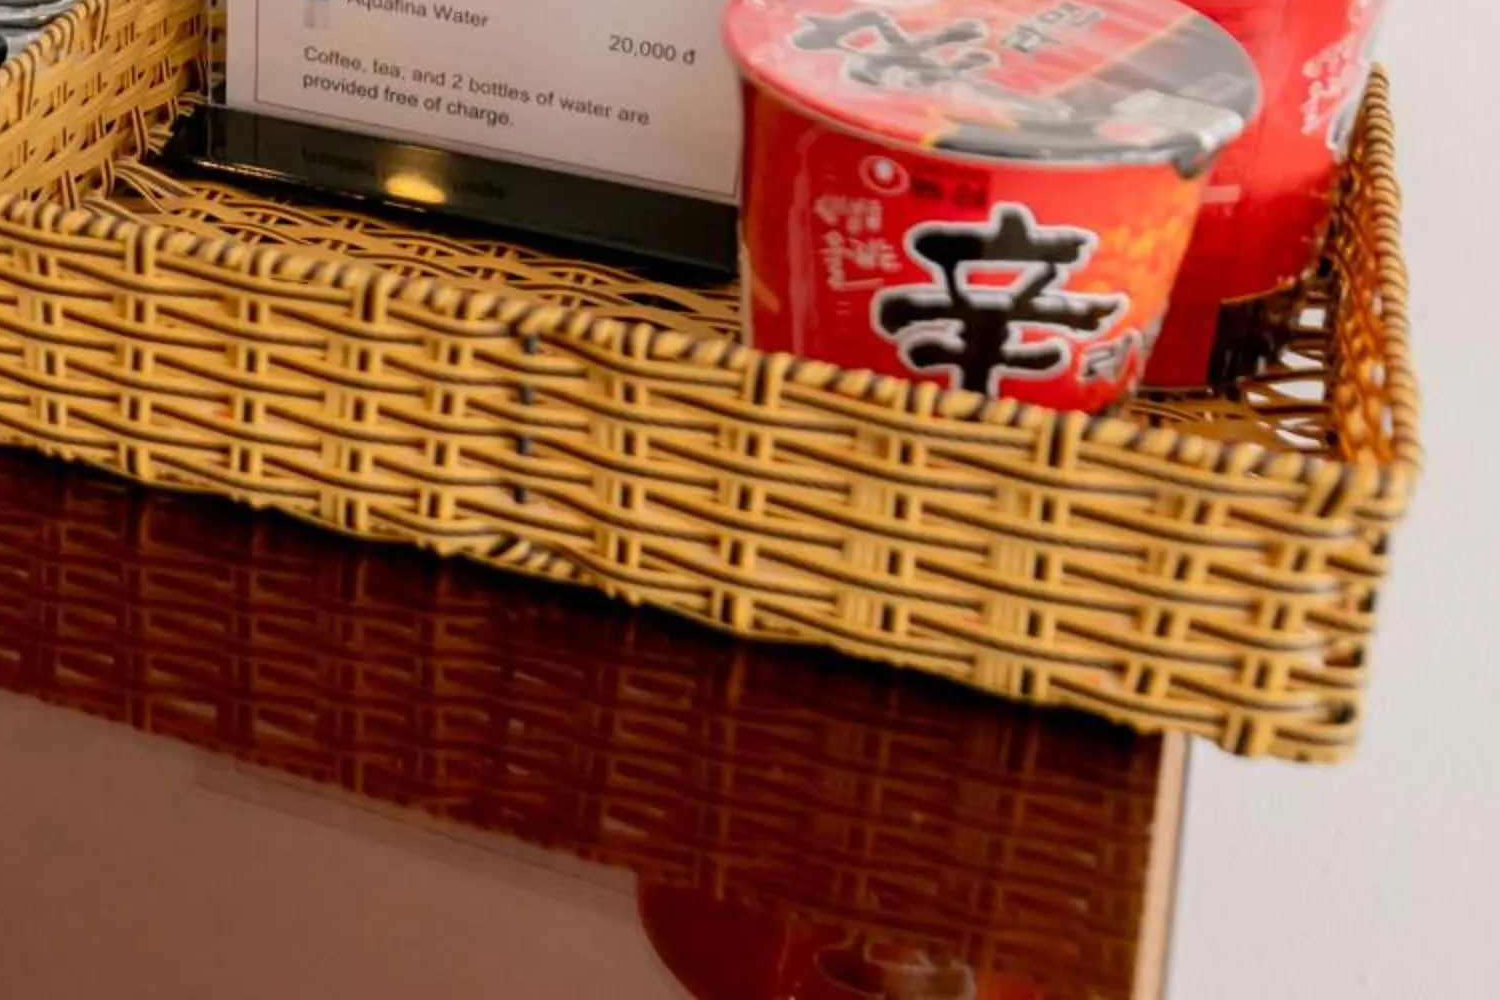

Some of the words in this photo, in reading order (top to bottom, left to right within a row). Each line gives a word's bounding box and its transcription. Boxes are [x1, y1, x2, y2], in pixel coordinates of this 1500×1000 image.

[432, 3, 489, 28] Water
[303, 45, 367, 73] Coffee,
[373, 59, 405, 81] tea,
[412, 67, 446, 88] and
[451, 73, 463, 89] 2
[469, 77, 531, 104] bottles
[536, 91, 555, 107] of
[559, 97, 613, 119] water
[617, 109, 651, 127] are
[303, 73, 379, 100] provided
[383, 85, 419, 107] free
[423, 96, 442, 113] of
[446, 101, 516, 128] charge.
